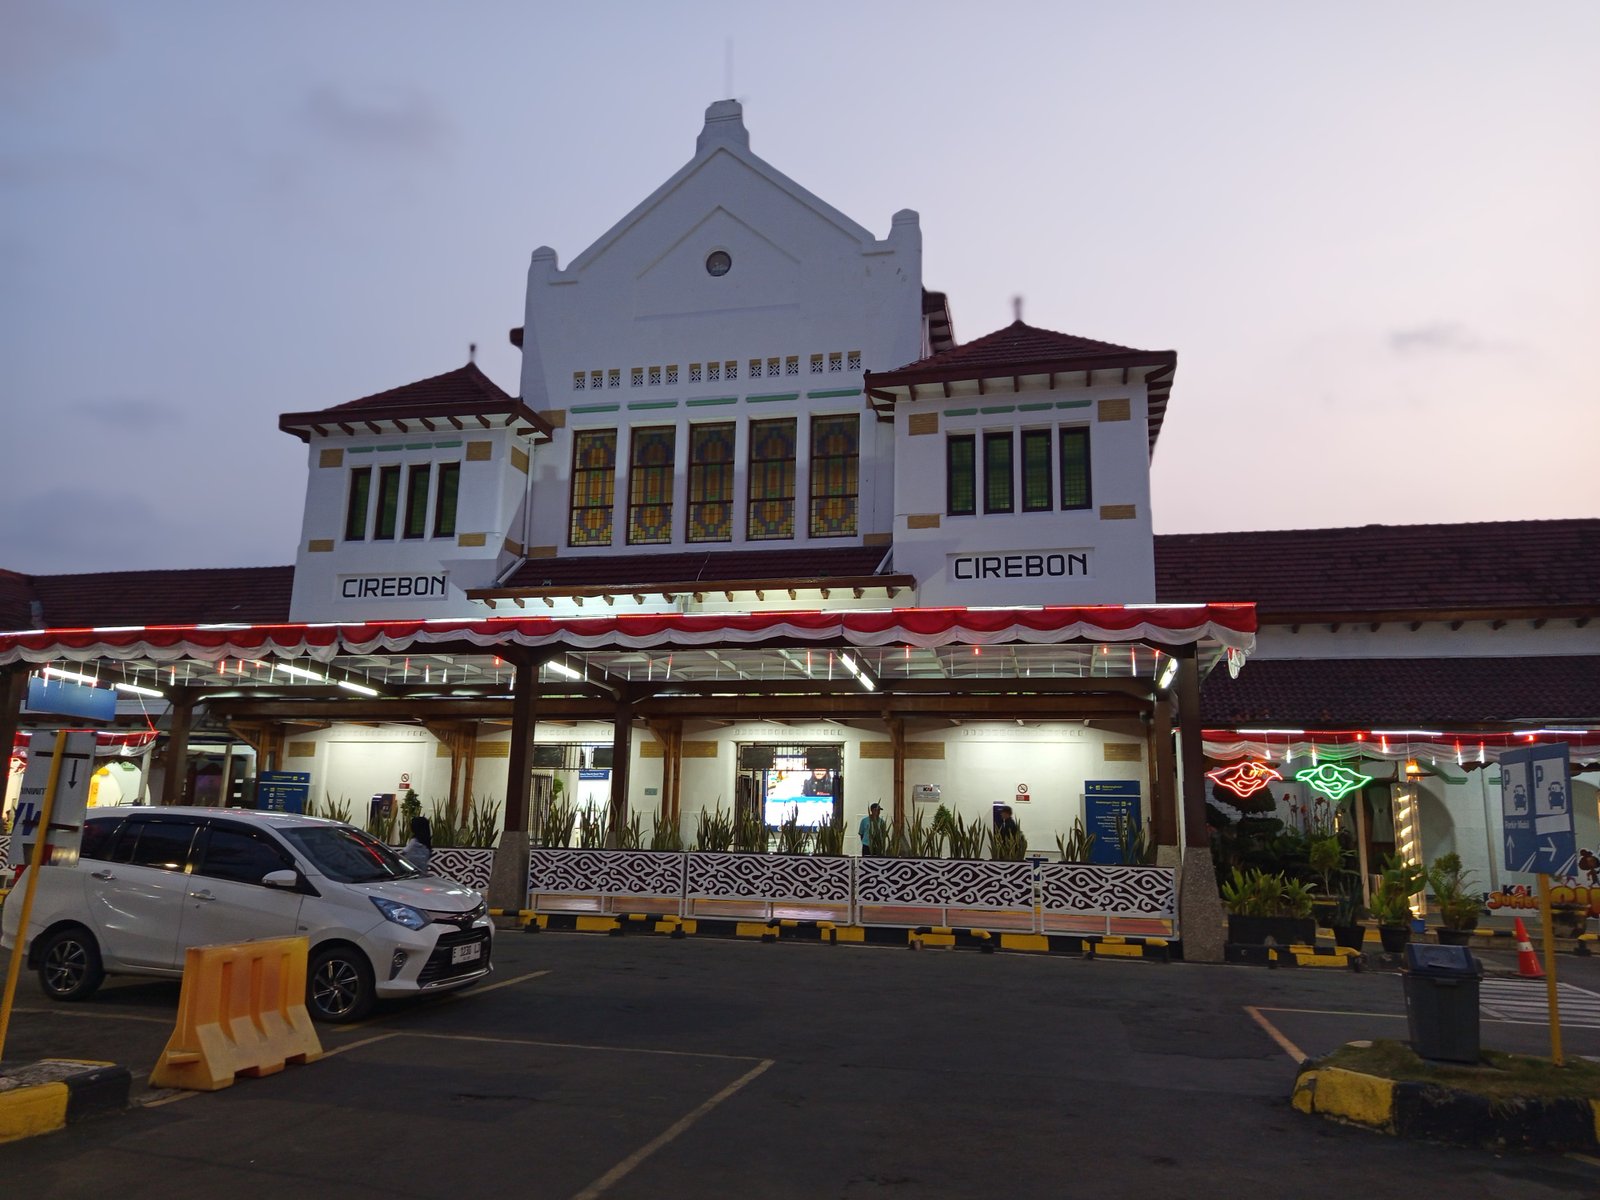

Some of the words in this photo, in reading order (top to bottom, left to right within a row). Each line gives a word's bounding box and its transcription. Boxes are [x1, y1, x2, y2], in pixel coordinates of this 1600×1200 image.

[954, 553, 1087, 579] CIREBON
[342, 576, 446, 597] CIREBON
[1503, 768, 1511, 791] P
[1534, 764, 1544, 789] P
